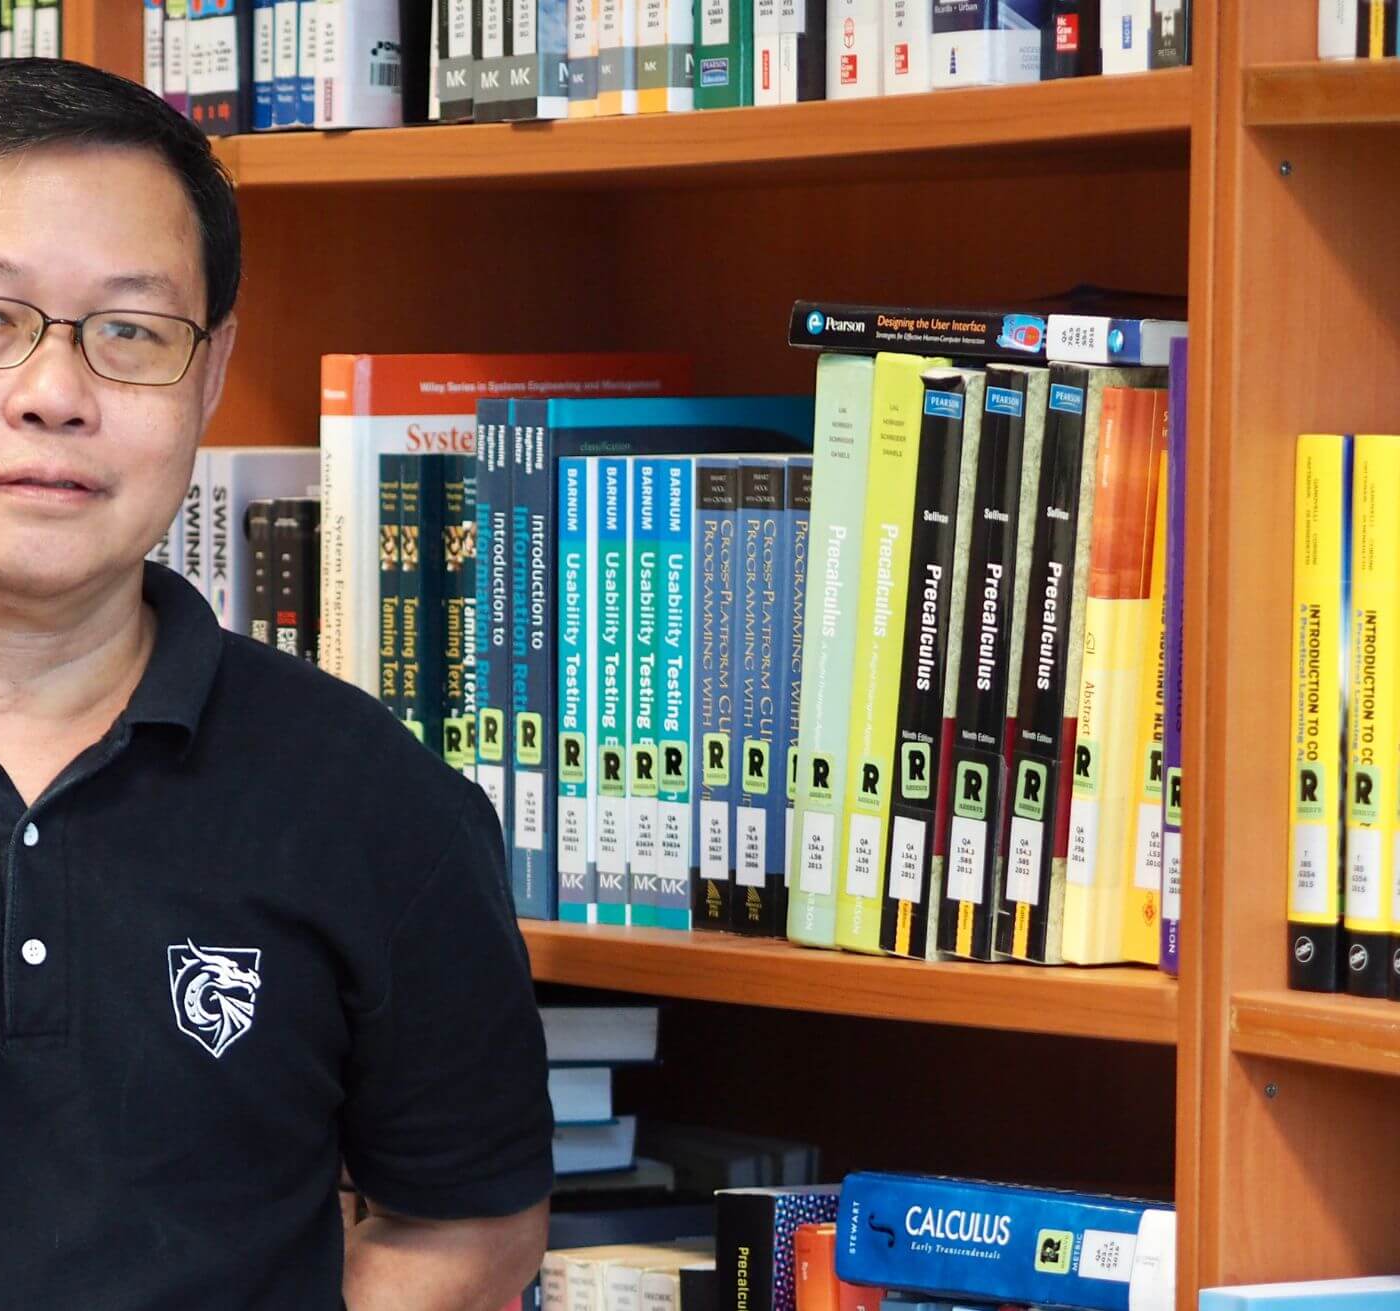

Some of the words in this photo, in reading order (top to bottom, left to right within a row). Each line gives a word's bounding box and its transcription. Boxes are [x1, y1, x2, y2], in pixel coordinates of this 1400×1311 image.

[447, 69, 466, 88] MK
[481, 70, 499, 89] MK
[511, 67, 530, 86] MK
[825, 315, 865, 333] Pearson
[877, 315, 914, 331] Designing
[916, 318, 929, 329] the
[931, 318, 950, 330] User
[952, 320, 987, 333] Interface
[420, 381, 445, 395] Wiley
[447, 381, 475, 393] Series
[488, 381, 526, 394] Systems
[528, 380, 581, 394] Engineering
[931, 396, 960, 409] PEARSON
[991, 393, 1020, 407] PEARSON
[1055, 391, 1081, 404] PEARSON
[497, 425, 505, 468] Manning
[535, 427, 543, 470] Manning
[566, 468, 578, 531] BARNUM
[605, 466, 618, 531] BARNUM
[641, 466, 653, 530] BARNUM
[669, 468, 681, 532] BARNUM
[984, 507, 1009, 522] Sullivan
[1046, 506, 1070, 521] Sullivan
[187, 484, 200, 578] SWINK
[213, 486, 226, 579] SWINK
[923, 510, 949, 524] Sullivan
[476, 504, 490, 653] Information
[493, 512, 508, 625] Introduction
[513, 506, 528, 657] Information
[531, 515, 546, 626] Introduction
[822, 524, 847, 638] Precalculus
[873, 522, 899, 638] Precalculus
[563, 553, 580, 646] Usability
[602, 552, 620, 646] Usability
[637, 552, 655, 646] Usability
[665, 554, 683, 648] Usability
[702, 519, 717, 671] PROGRAMMING
[719, 519, 733, 689] CROSS-PLATFORM
[743, 519, 760, 671] PROGRAMMING
[760, 519, 776, 690] CROSS-PLATFORM
[790, 519, 808, 673] PROGRAMMING
[382, 596, 398, 659] Taming
[402, 597, 418, 659] Taming
[447, 598, 464, 659] Taming
[493, 627, 505, 646] to
[532, 631, 544, 649] to
[917, 564, 942, 691] Precalculus
[977, 563, 1003, 691] Precalculus
[1037, 561, 1063, 690] Precalculus
[1307, 604, 1321, 714] INTRODUCTION
[1363, 610, 1377, 720] INTRODUCTION
[383, 662, 398, 697] Text
[403, 662, 418, 698] Text
[448, 663, 463, 698] Text
[563, 653, 580, 729] Testing
[602, 652, 620, 729] Testing
[636, 652, 655, 730] Testing
[664, 655, 683, 733] Testing
[702, 677, 714, 727] WITH
[743, 678, 755, 728] WITH
[1082, 681, 1095, 735] Abstract
[447, 727, 462, 752] R
[485, 716, 498, 743] R
[523, 721, 536, 748] R
[962, 729, 977, 741] Ninth
[978, 732, 996, 745] Edition
[1022, 729, 1036, 741] Ninth
[1036, 732, 1053, 744] Edition
[1306, 718, 1319, 736] TO
[1362, 724, 1374, 743] TO
[565, 738, 580, 767] R
[604, 752, 620, 781] R
[637, 751, 653, 779] R
[665, 747, 682, 776] R
[709, 740, 724, 769] R
[749, 747, 764, 777] R
[908, 750, 925, 781] R
[1076, 744, 1091, 778] R
[1150, 750, 1162, 782] R
[813, 758, 829, 788] R
[863, 763, 879, 795] R
[963, 768, 982, 802] R
[1023, 768, 1041, 802] R
[1300, 770, 1318, 801] R
[1355, 772, 1372, 805] R
[812, 834, 821, 842] QA
[860, 838, 868, 846] QA
[962, 838, 971, 846] QA
[1020, 838, 1029, 846] QA
[1076, 826, 1084, 834] QA
[1151, 831, 1159, 839] QA
[562, 874, 584, 889] MK
[600, 874, 622, 890] MK
[808, 861, 823, 870] 2013
[957, 866, 973, 875] 2012
[1015, 866, 1030, 875] 2012
[634, 875, 658, 892] MK
[662, 879, 685, 895] MK
[849, 1201, 860, 1254] STEWART
[905, 1205, 1012, 1246] CALCULUS
[911, 1241, 932, 1254] Early
[936, 1244, 1001, 1260] Transcendentals
[1040, 1238, 1061, 1264] R
[1071, 1233, 1083, 1272] METRIC
